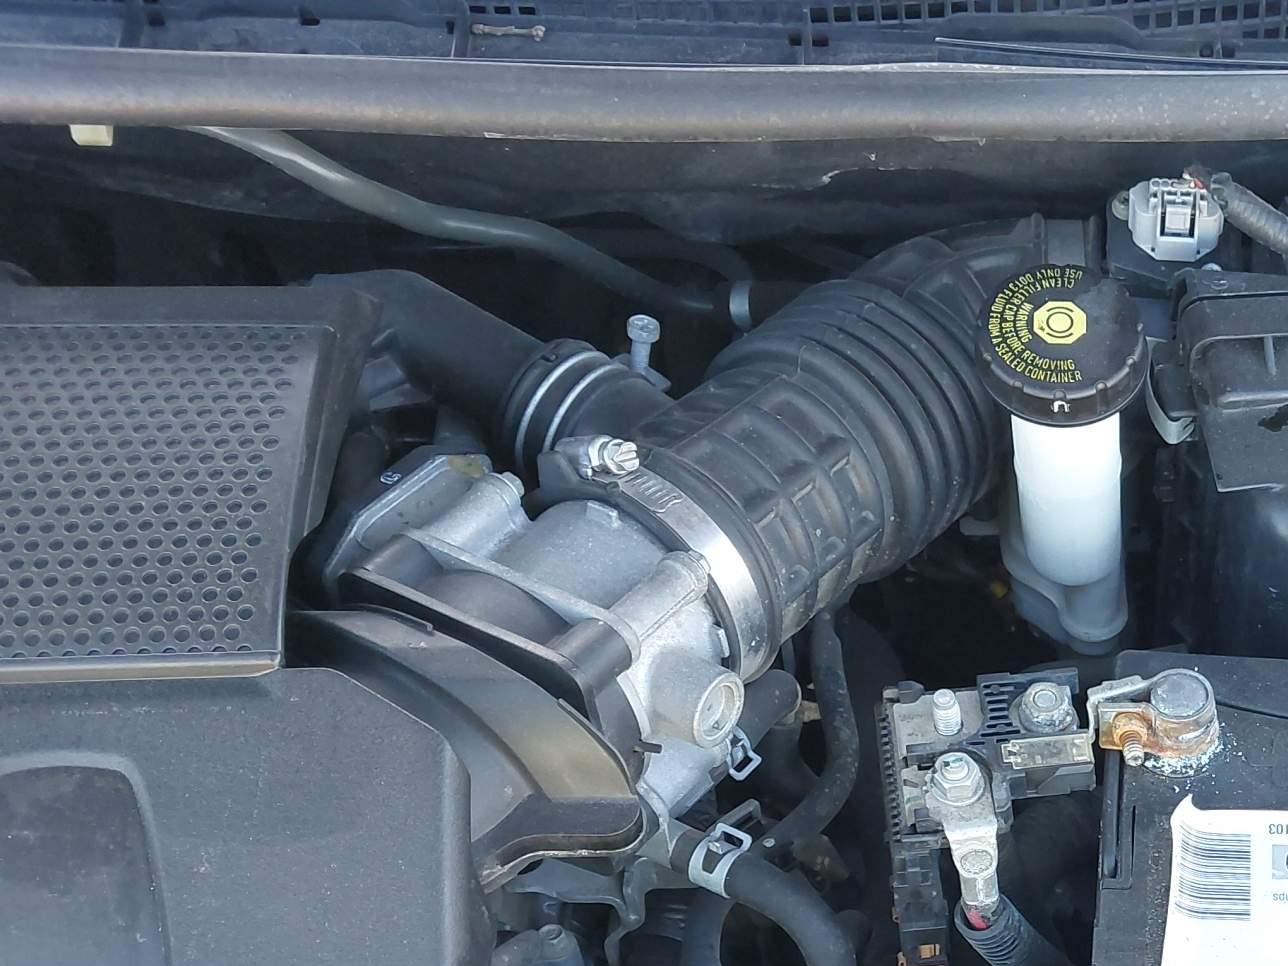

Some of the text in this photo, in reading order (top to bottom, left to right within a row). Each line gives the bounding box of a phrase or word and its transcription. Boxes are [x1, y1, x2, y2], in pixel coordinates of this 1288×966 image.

[1036, 268, 1061, 280] ONLY
[1064, 268, 1083, 280] USE
[991, 289, 1012, 312] FLUID
[988, 312, 1001, 337] FROM
[1001, 278, 1075, 371] CLEAN FILLER CAP BEFORE REMOVING
[1016, 302, 1035, 343] WARNING
[995, 343, 1026, 372] SEALED
[1025, 363, 1082, 383] CONTAINER
